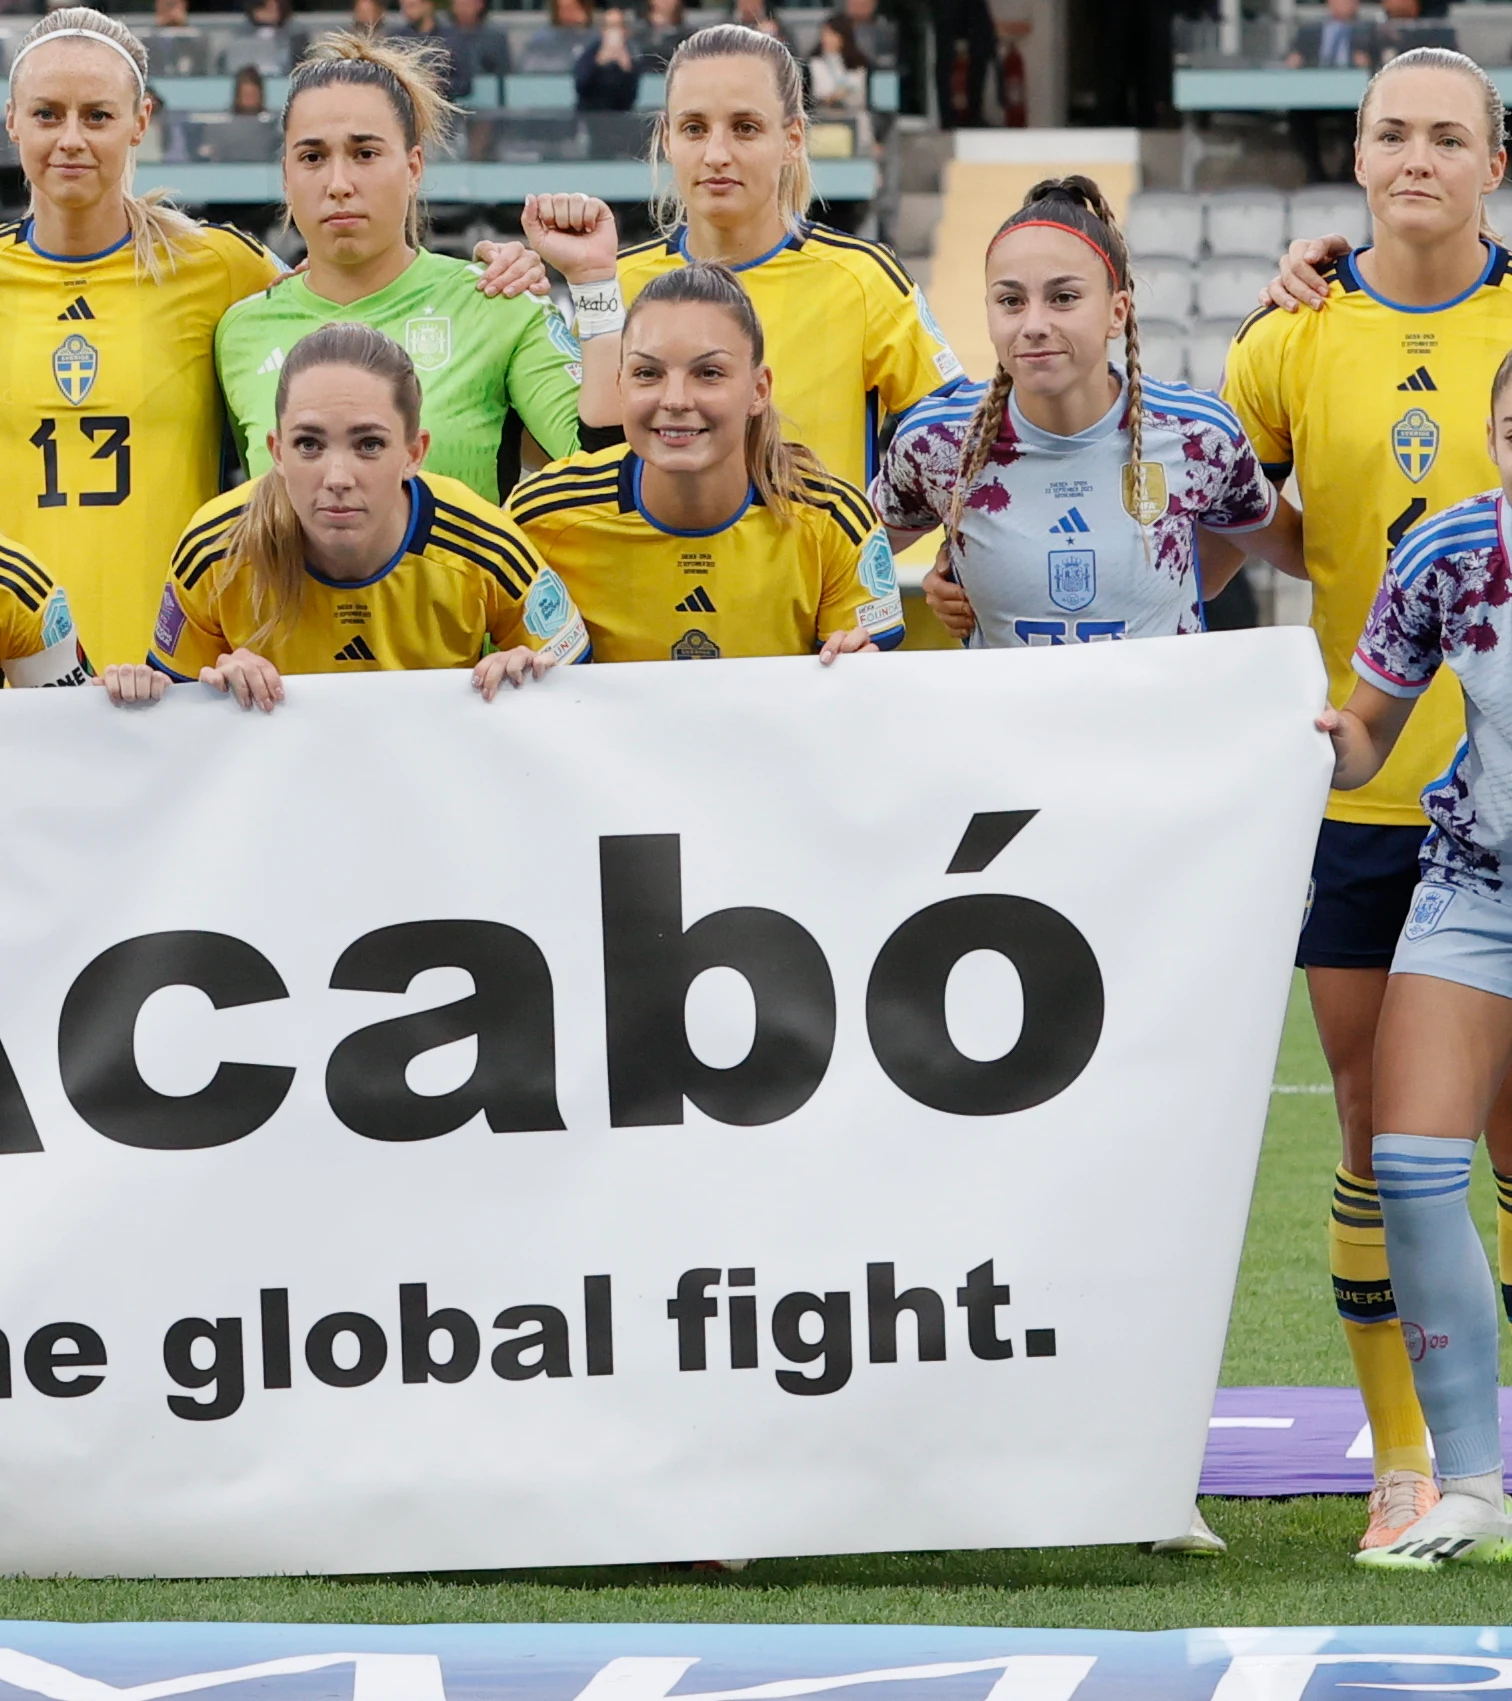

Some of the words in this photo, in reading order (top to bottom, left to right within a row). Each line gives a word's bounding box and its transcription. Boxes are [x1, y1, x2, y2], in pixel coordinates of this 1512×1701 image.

[29, 416, 130, 508] 13
[164, 1288, 613, 1421] global
[667, 1259, 1056, 1396] fight.
